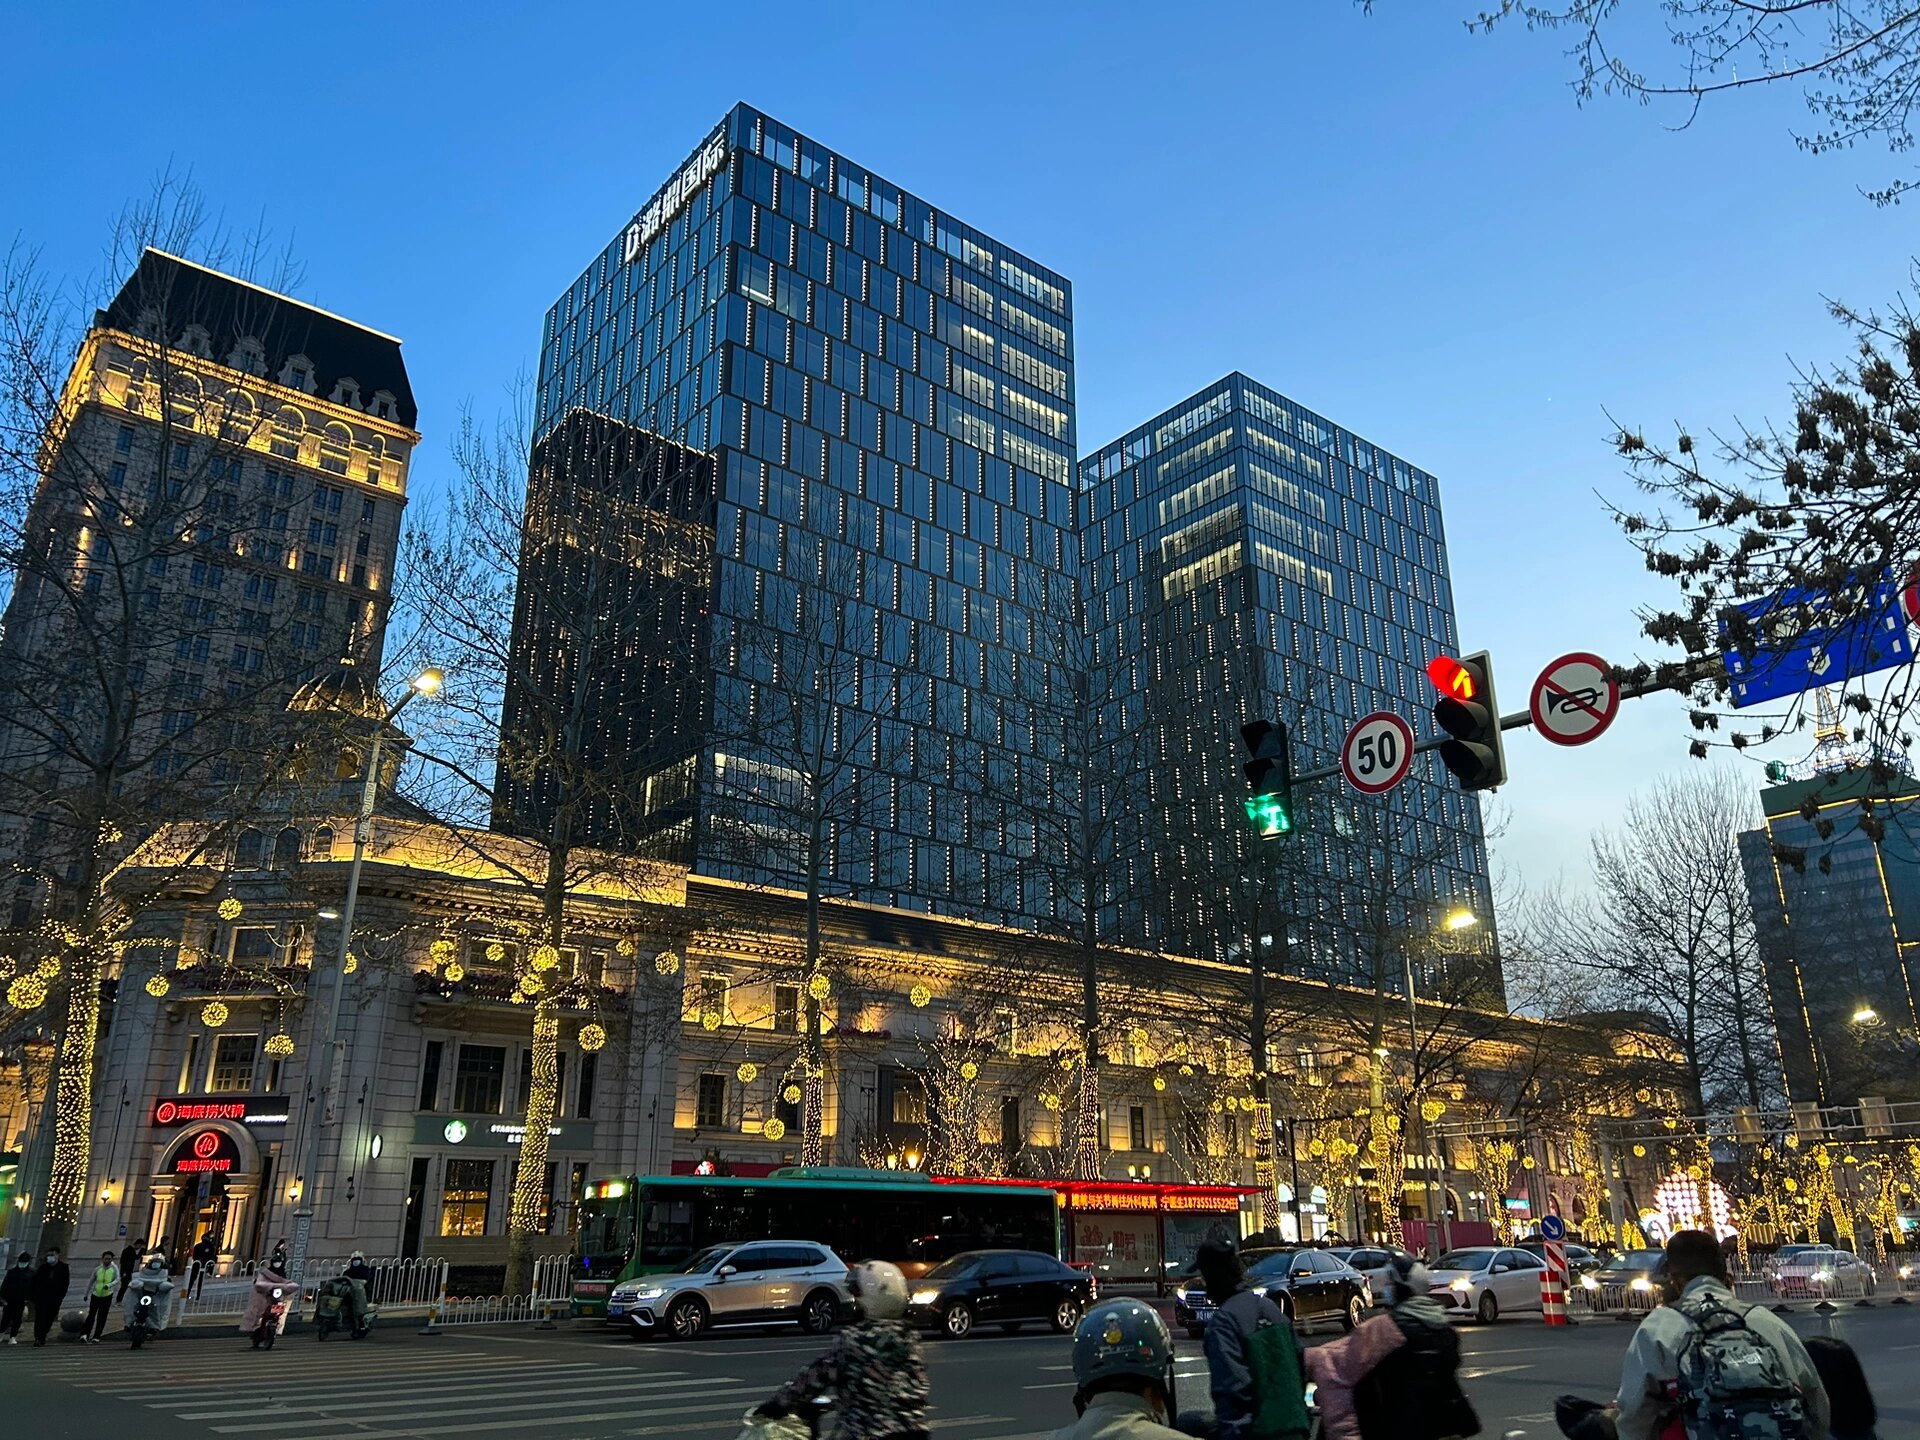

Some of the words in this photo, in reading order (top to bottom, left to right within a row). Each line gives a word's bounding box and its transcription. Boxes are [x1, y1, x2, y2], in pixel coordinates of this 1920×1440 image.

[1358, 730, 1397, 775] 50
[177, 1104, 245, 1119] 海底捞火锅
[490, 1124, 528, 1134] STARBUC
[176, 1159, 231, 1172] 海底捞火锅
